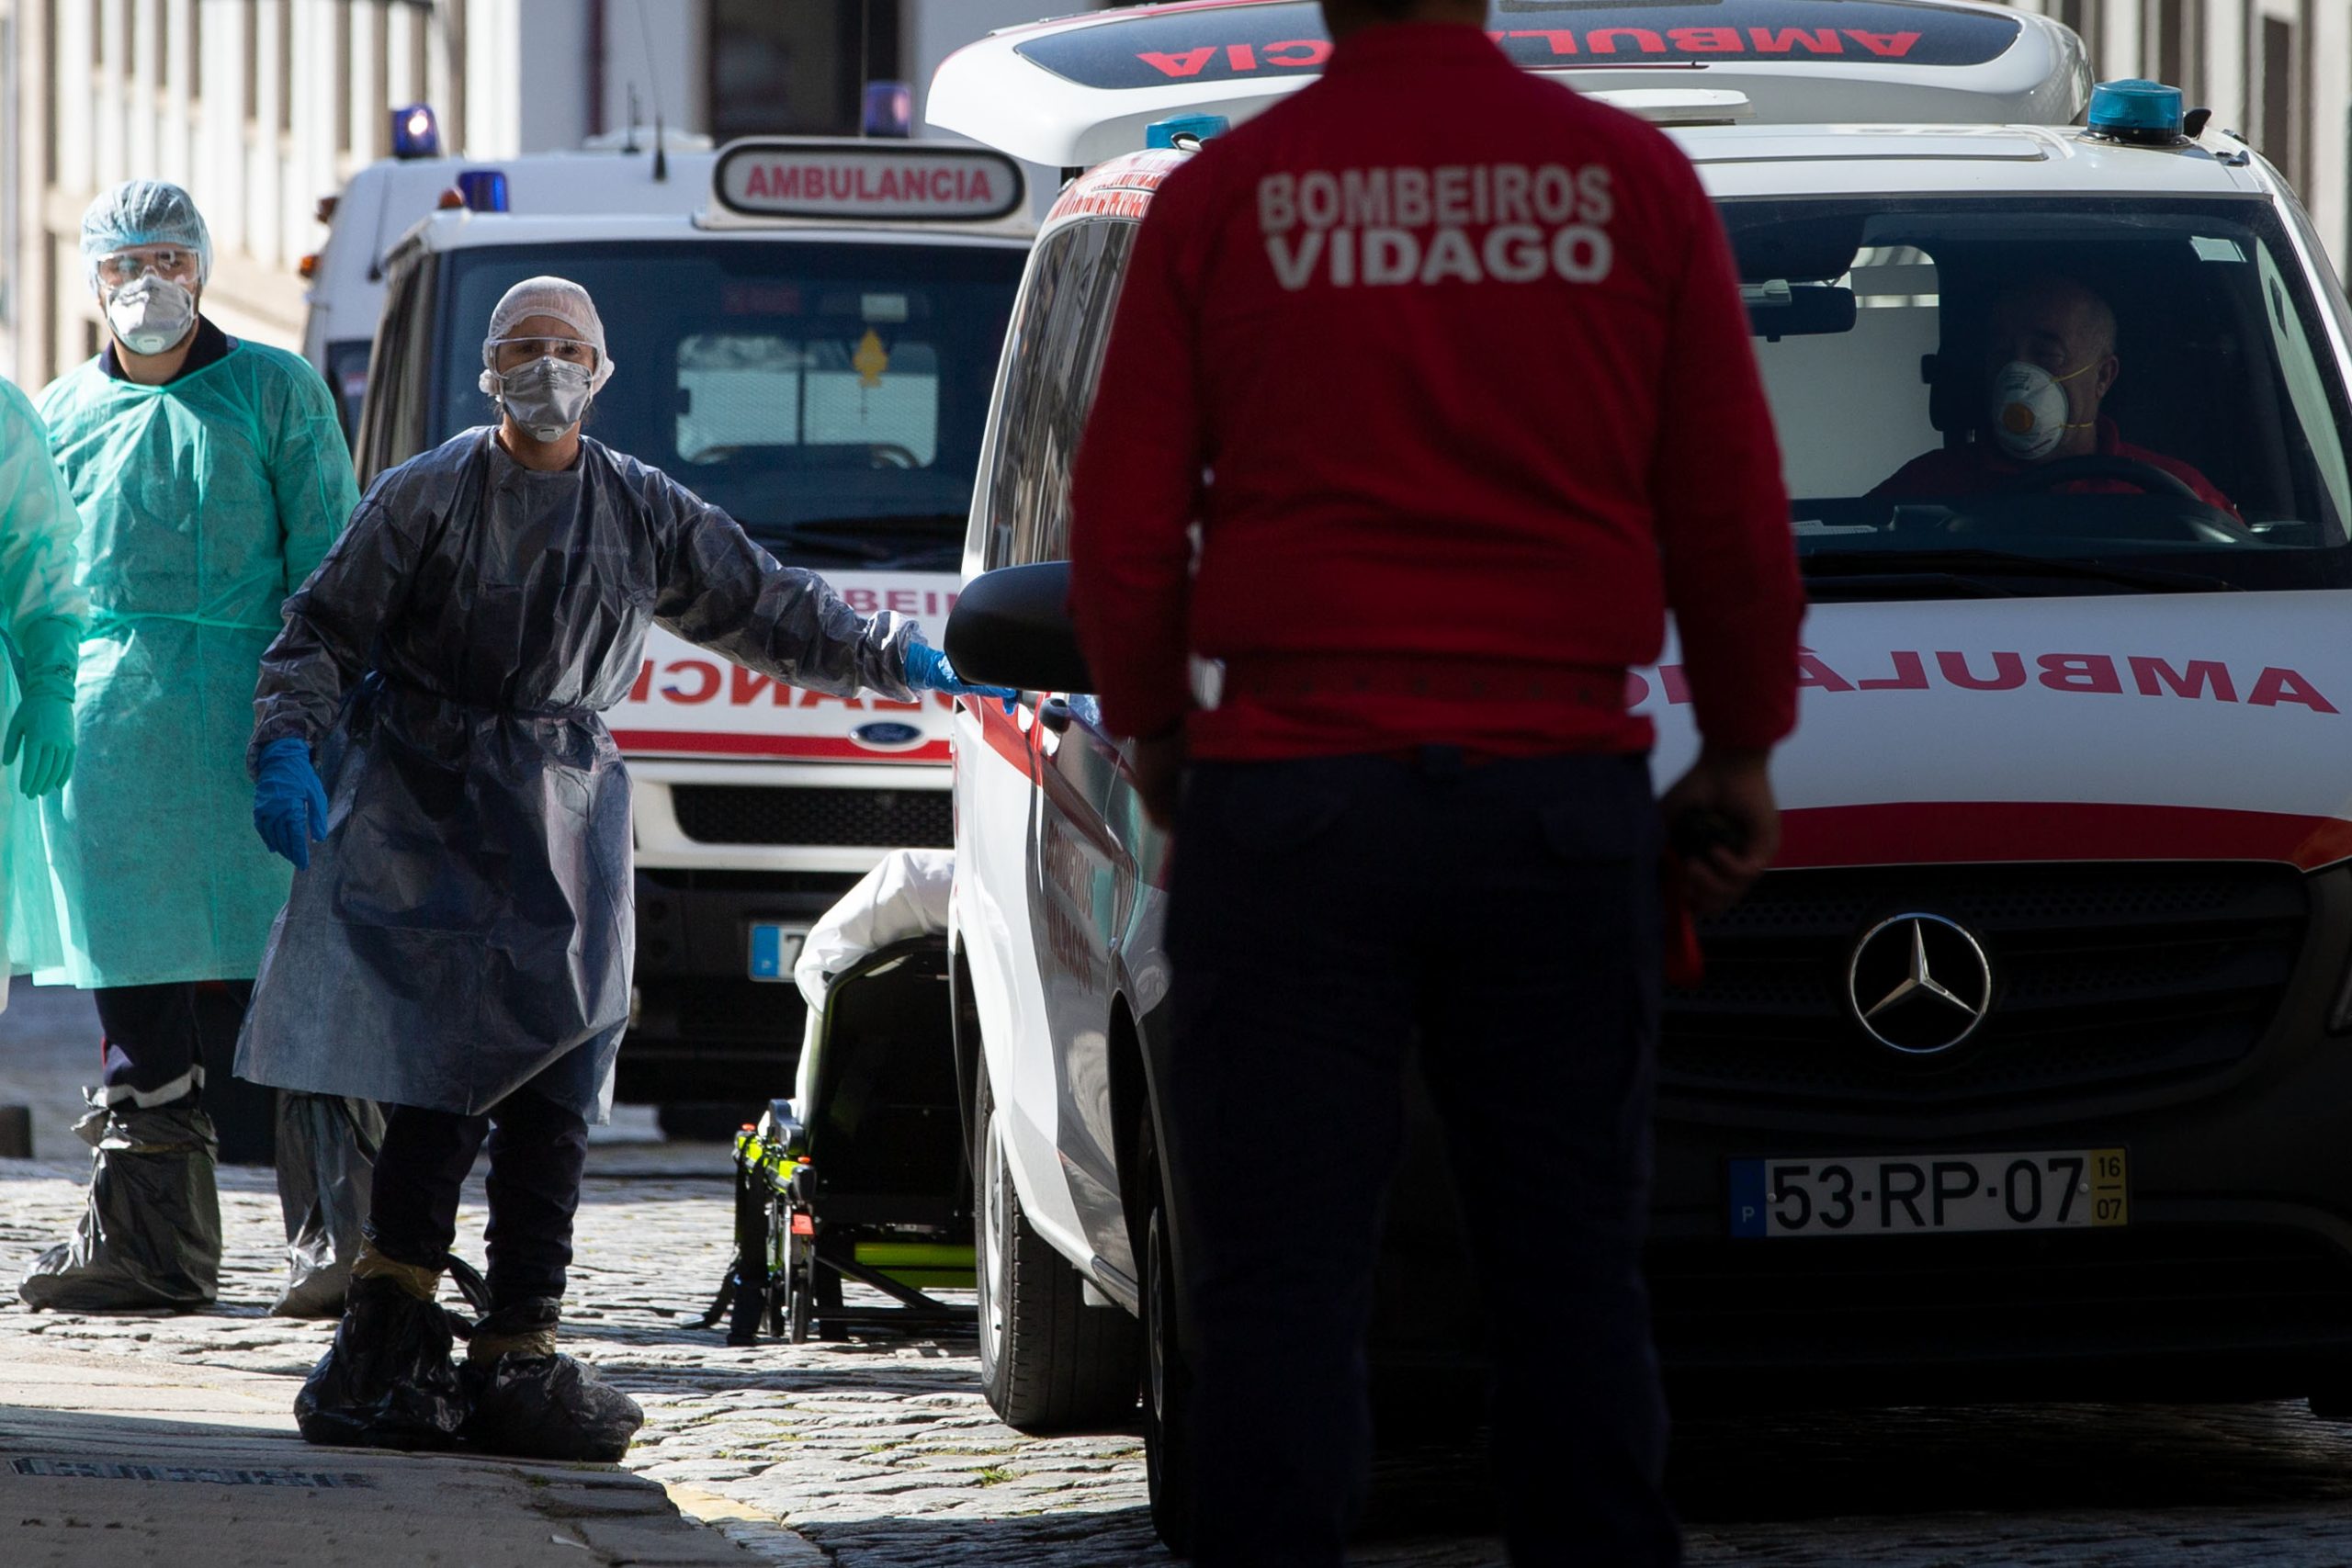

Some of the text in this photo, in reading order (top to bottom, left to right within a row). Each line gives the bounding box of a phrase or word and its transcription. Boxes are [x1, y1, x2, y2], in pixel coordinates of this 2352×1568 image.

[1136, 27, 1926, 77] AMBULCIA
[745, 165, 992, 203] AMBULANCIA
[1256, 163, 1614, 233] BOMBEIROS
[1264, 223, 1614, 291] VIDAGO
[2097, 1156, 2121, 1179] 16
[1742, 1205, 1755, 1224] P
[2097, 1199, 2121, 1220] 07
